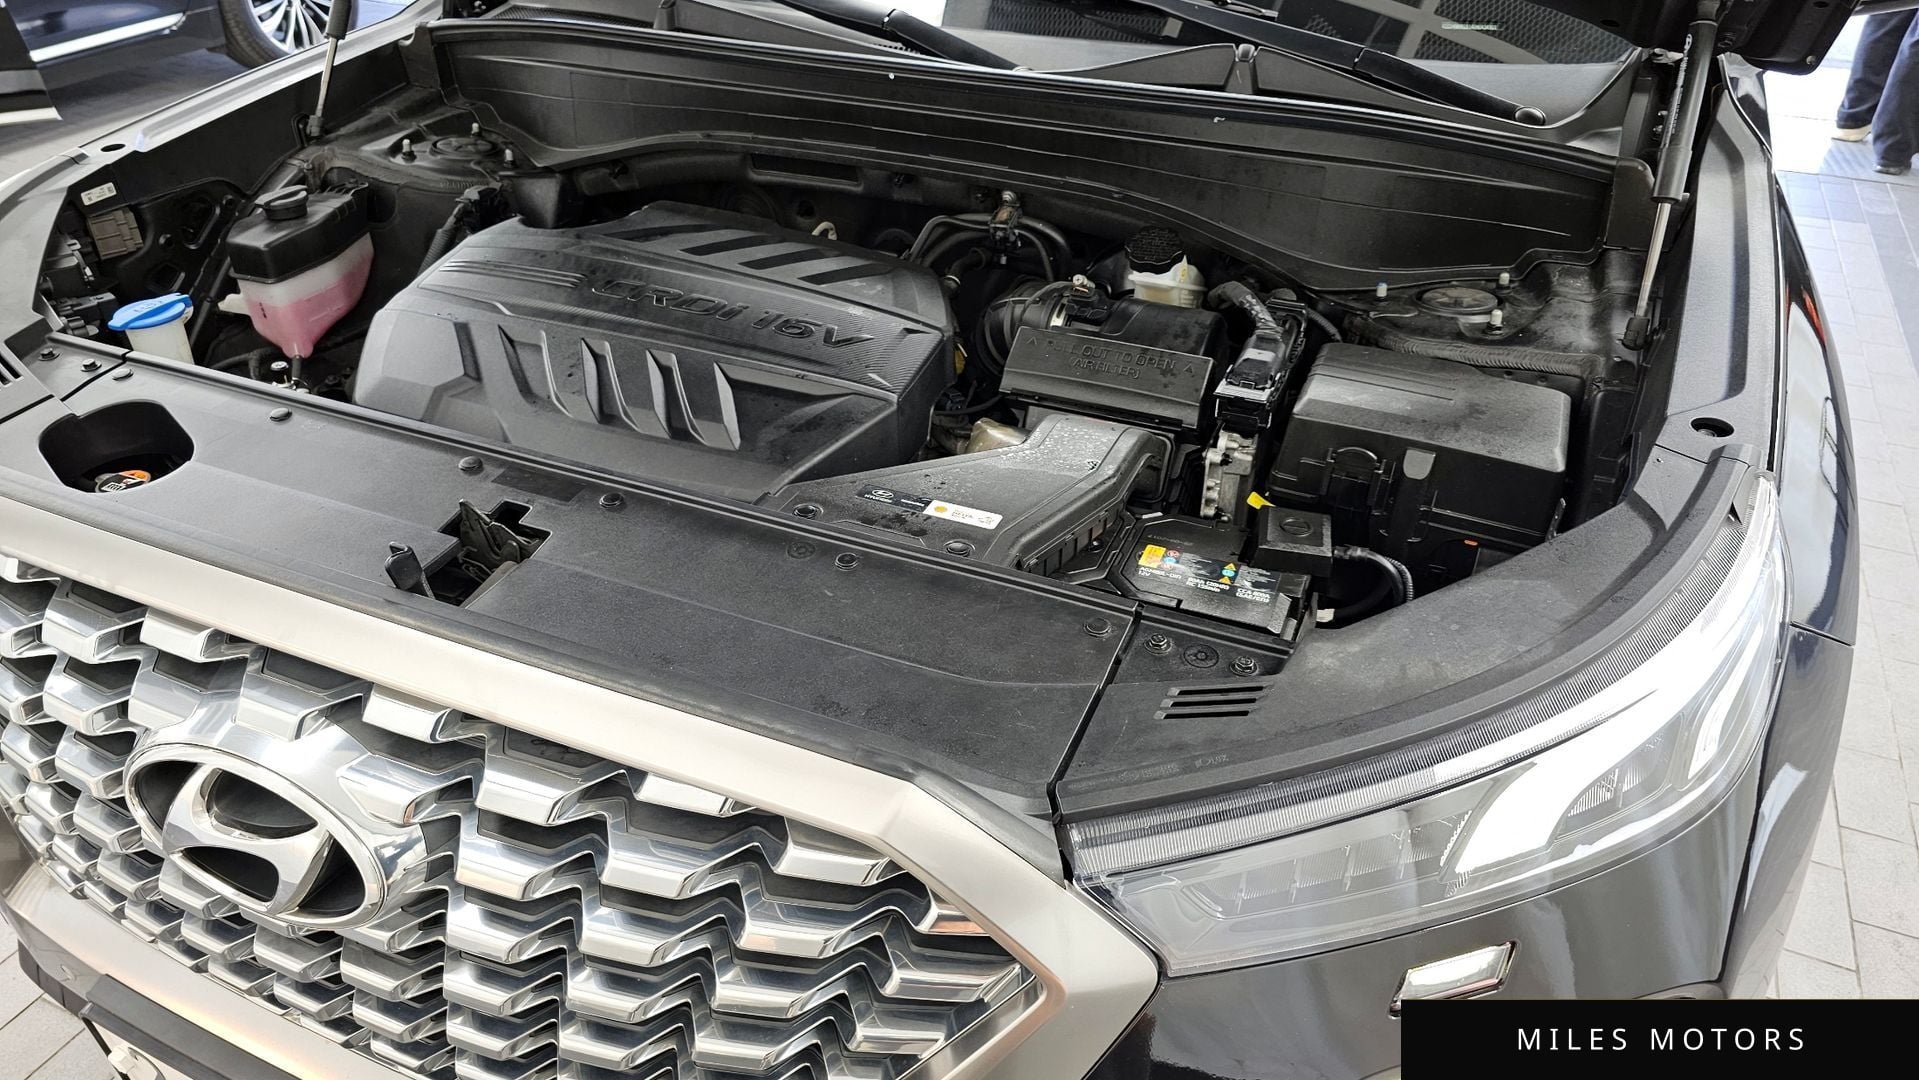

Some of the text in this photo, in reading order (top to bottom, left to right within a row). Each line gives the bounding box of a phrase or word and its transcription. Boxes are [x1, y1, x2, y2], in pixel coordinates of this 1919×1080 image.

[752, 310, 875, 348] 16V
[1082, 345, 1111, 360] OUT
[1113, 351, 1134, 363] TO
[1136, 354, 1177, 369] OPEN
